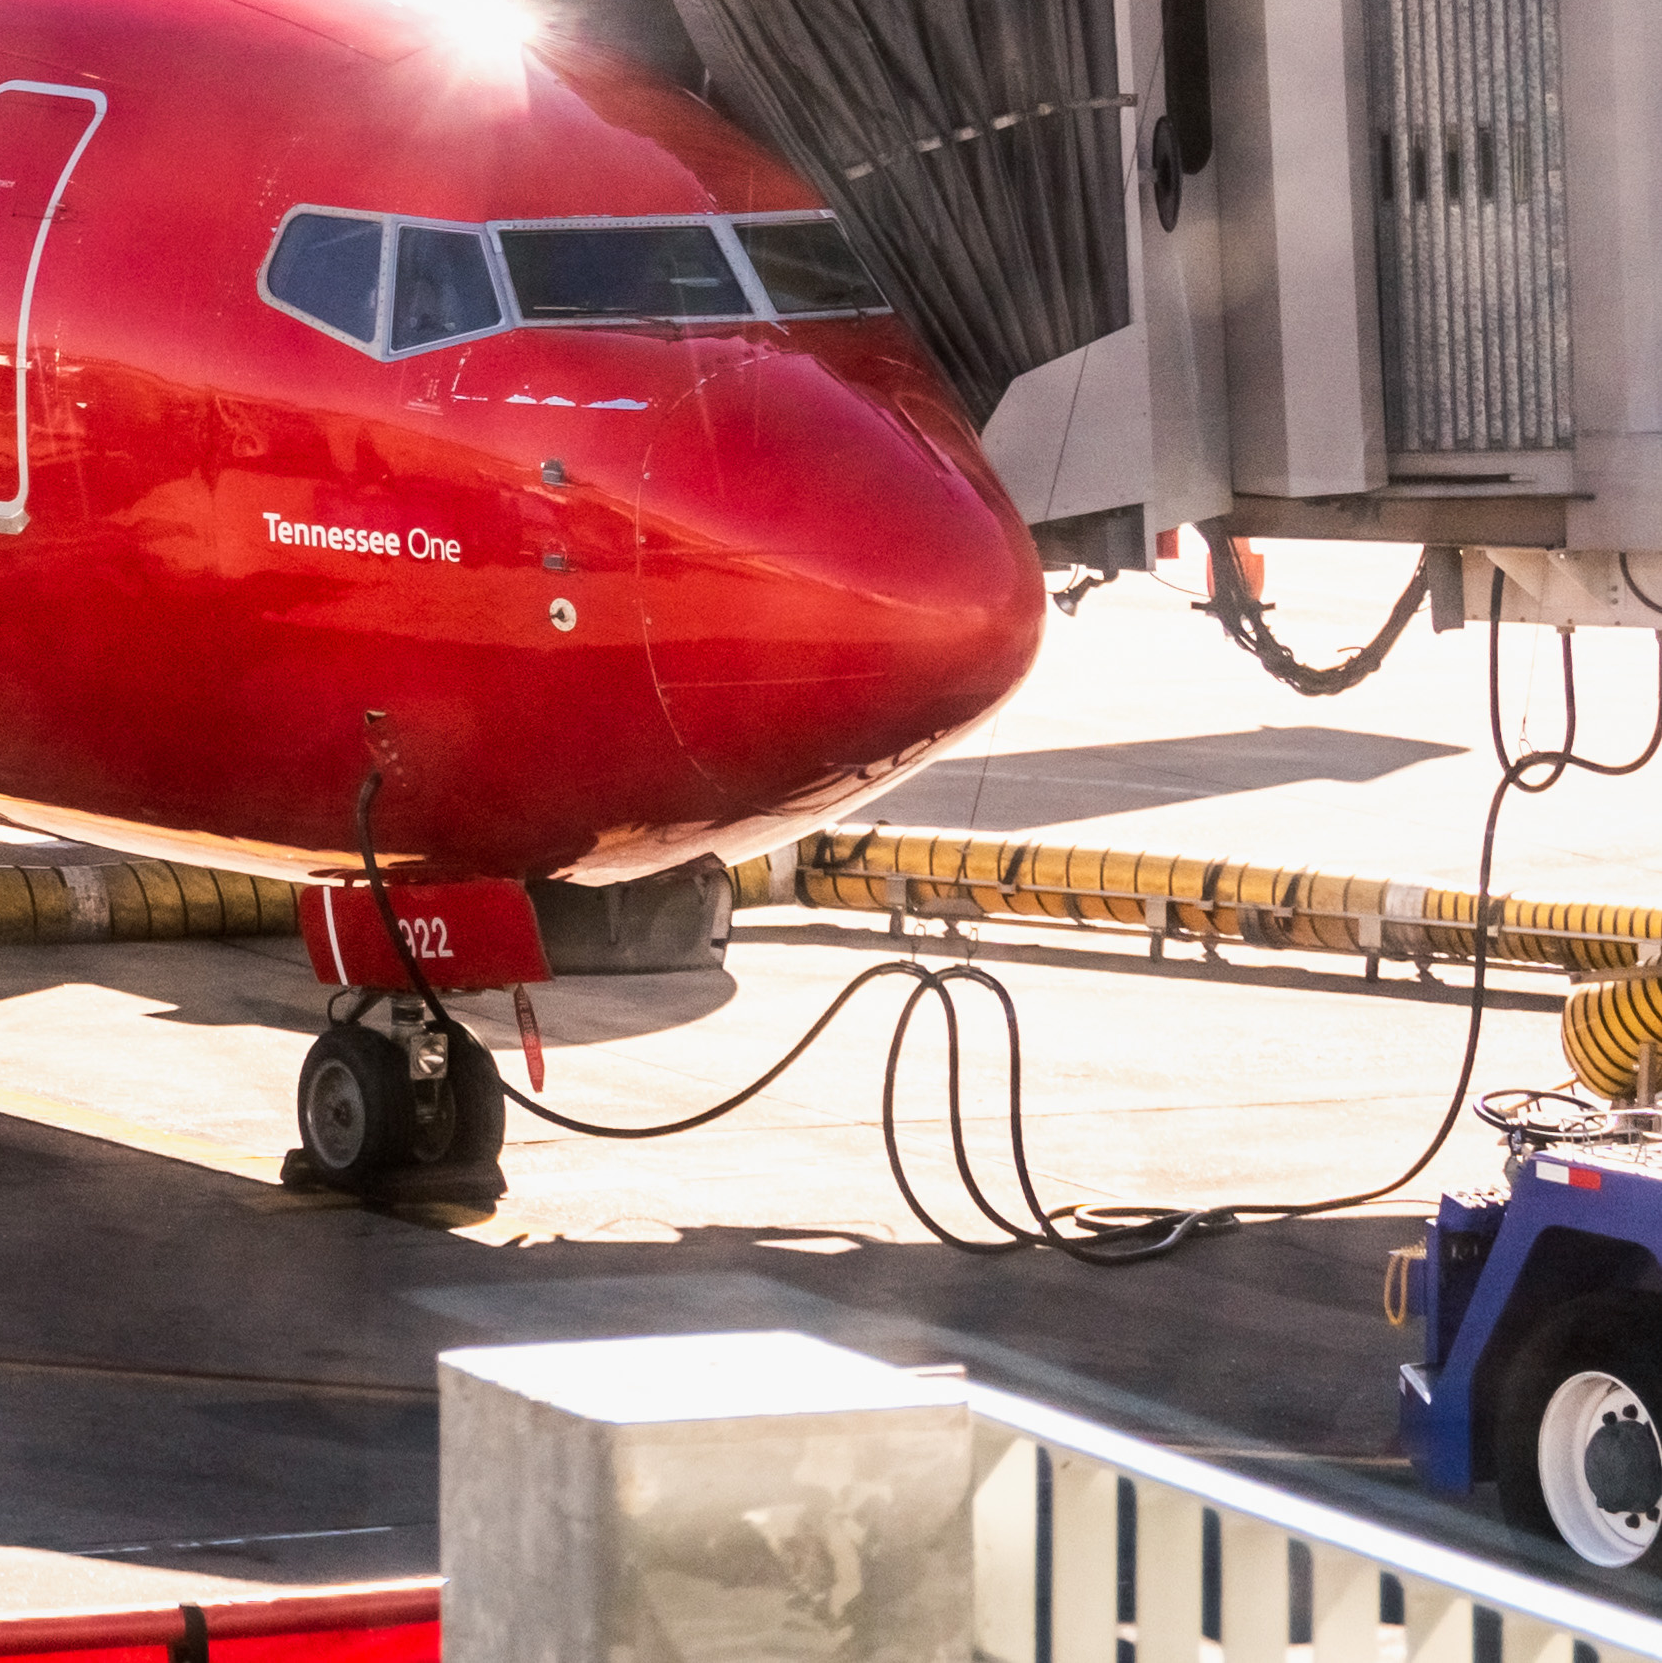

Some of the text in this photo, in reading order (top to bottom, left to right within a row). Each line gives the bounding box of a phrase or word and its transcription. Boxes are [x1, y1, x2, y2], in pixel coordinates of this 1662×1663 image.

[263, 512, 462, 563] Tennessee One
[398, 917, 455, 959] 922
